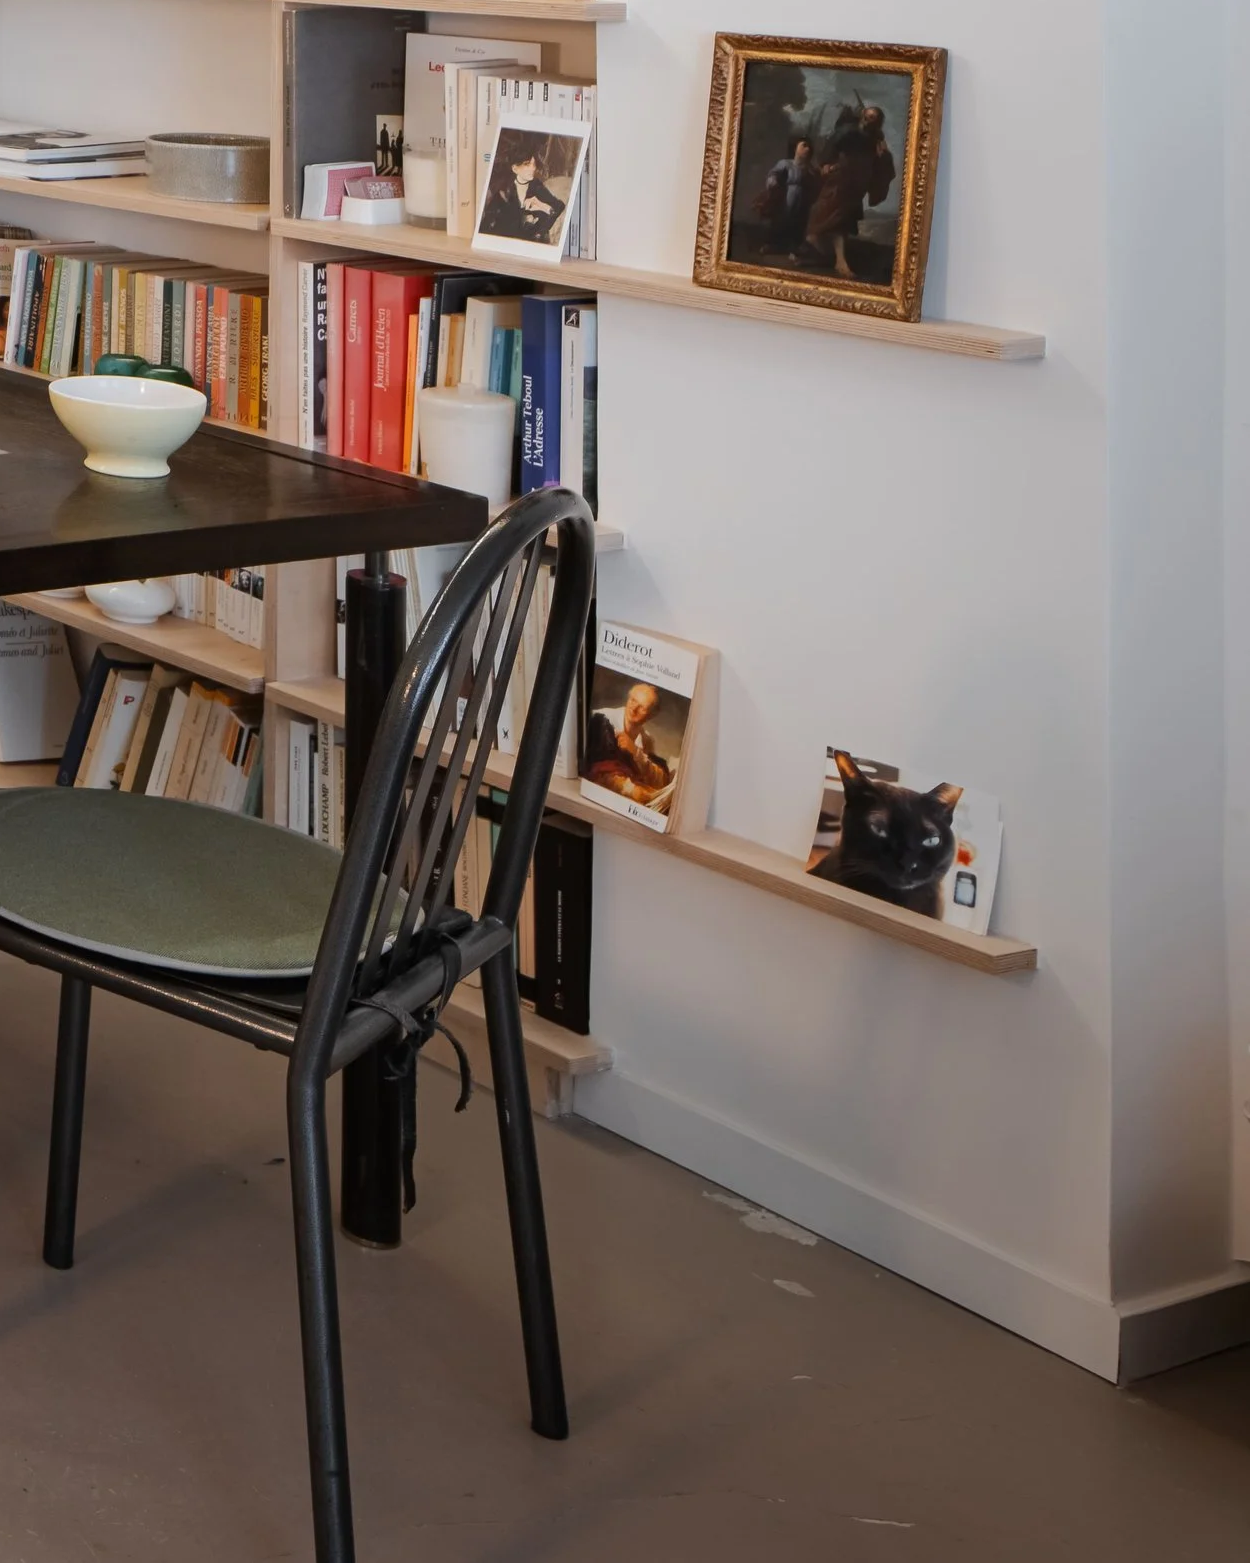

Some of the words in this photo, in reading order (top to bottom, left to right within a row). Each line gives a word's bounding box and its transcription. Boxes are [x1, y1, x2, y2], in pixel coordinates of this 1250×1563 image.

[28, 291, 39, 352] APOLLINAIRE
[173, 302, 182, 363] EOPARDI
[195, 299, 203, 335] PESSOA
[230, 309, 238, 347] RILKE
[240, 308, 249, 352] RIMBAUD
[347, 299, 357, 343] Carnets
[374, 307, 386, 349] d'Helen
[239, 357, 248, 395] ARTHUR
[373, 351, 387, 391] Journal
[523, 375, 532, 415] Teboul
[522, 416, 532, 464] Arthur
[533, 407, 543, 468] L'Adresse
[19, 627, 26, 638] et
[28, 625, 59, 640] Juliette
[21, 645, 38, 657] and
[40, 644, 64, 658] Juliet
[603, 629, 654, 658] Diderot
[601, 645, 625, 661] Lettres
[631, 656, 656, 670] Sophie
[657, 664, 681, 680] Volland
[321, 747, 329, 776] Robert
[321, 783, 329, 835] DUCHAMP
